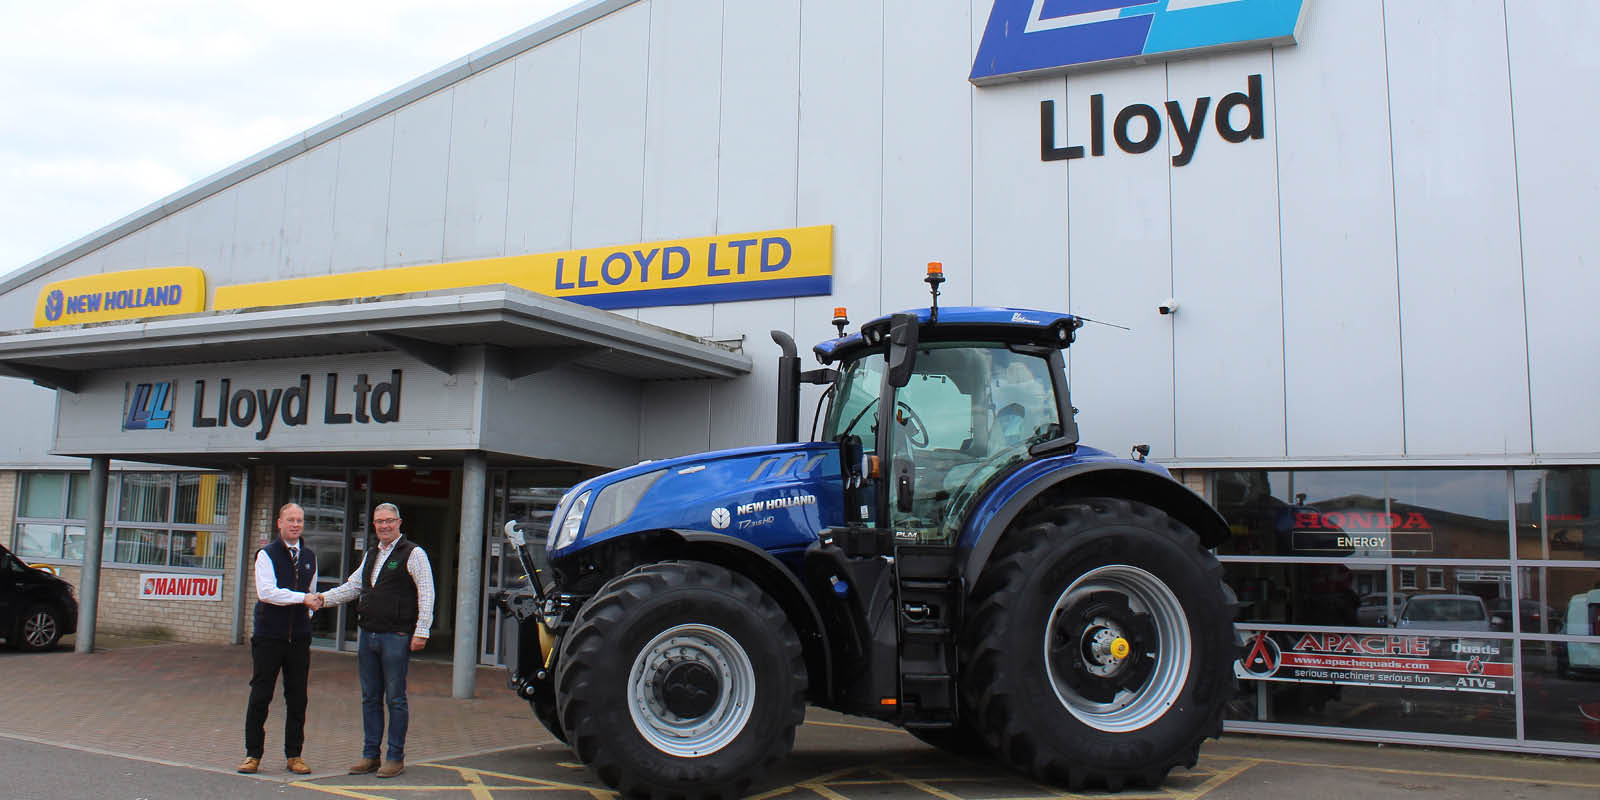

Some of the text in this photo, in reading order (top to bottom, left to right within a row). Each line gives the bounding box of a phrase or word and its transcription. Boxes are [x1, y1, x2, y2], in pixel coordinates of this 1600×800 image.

[1040, 74, 1265, 167] Lloyd
[555, 237, 792, 290] LLOYD LTD
[66, 284, 183, 315] NEW HOLLAND
[192, 369, 402, 441] Lloyd Ltd
[737, 495, 817, 516] NEW HOLLAND
[1293, 511, 1433, 529] HONDA
[1337, 537, 1386, 547] ENERGY
[155, 577, 218, 596] MANITOU
[1292, 632, 1430, 656] APACHE
[1451, 643, 1500, 655] Quads
[1294, 656, 1430, 669] www.apachequads.com
[1294, 669, 1430, 683] serious machines serious fun
[1456, 677, 1496, 689] ATVs
